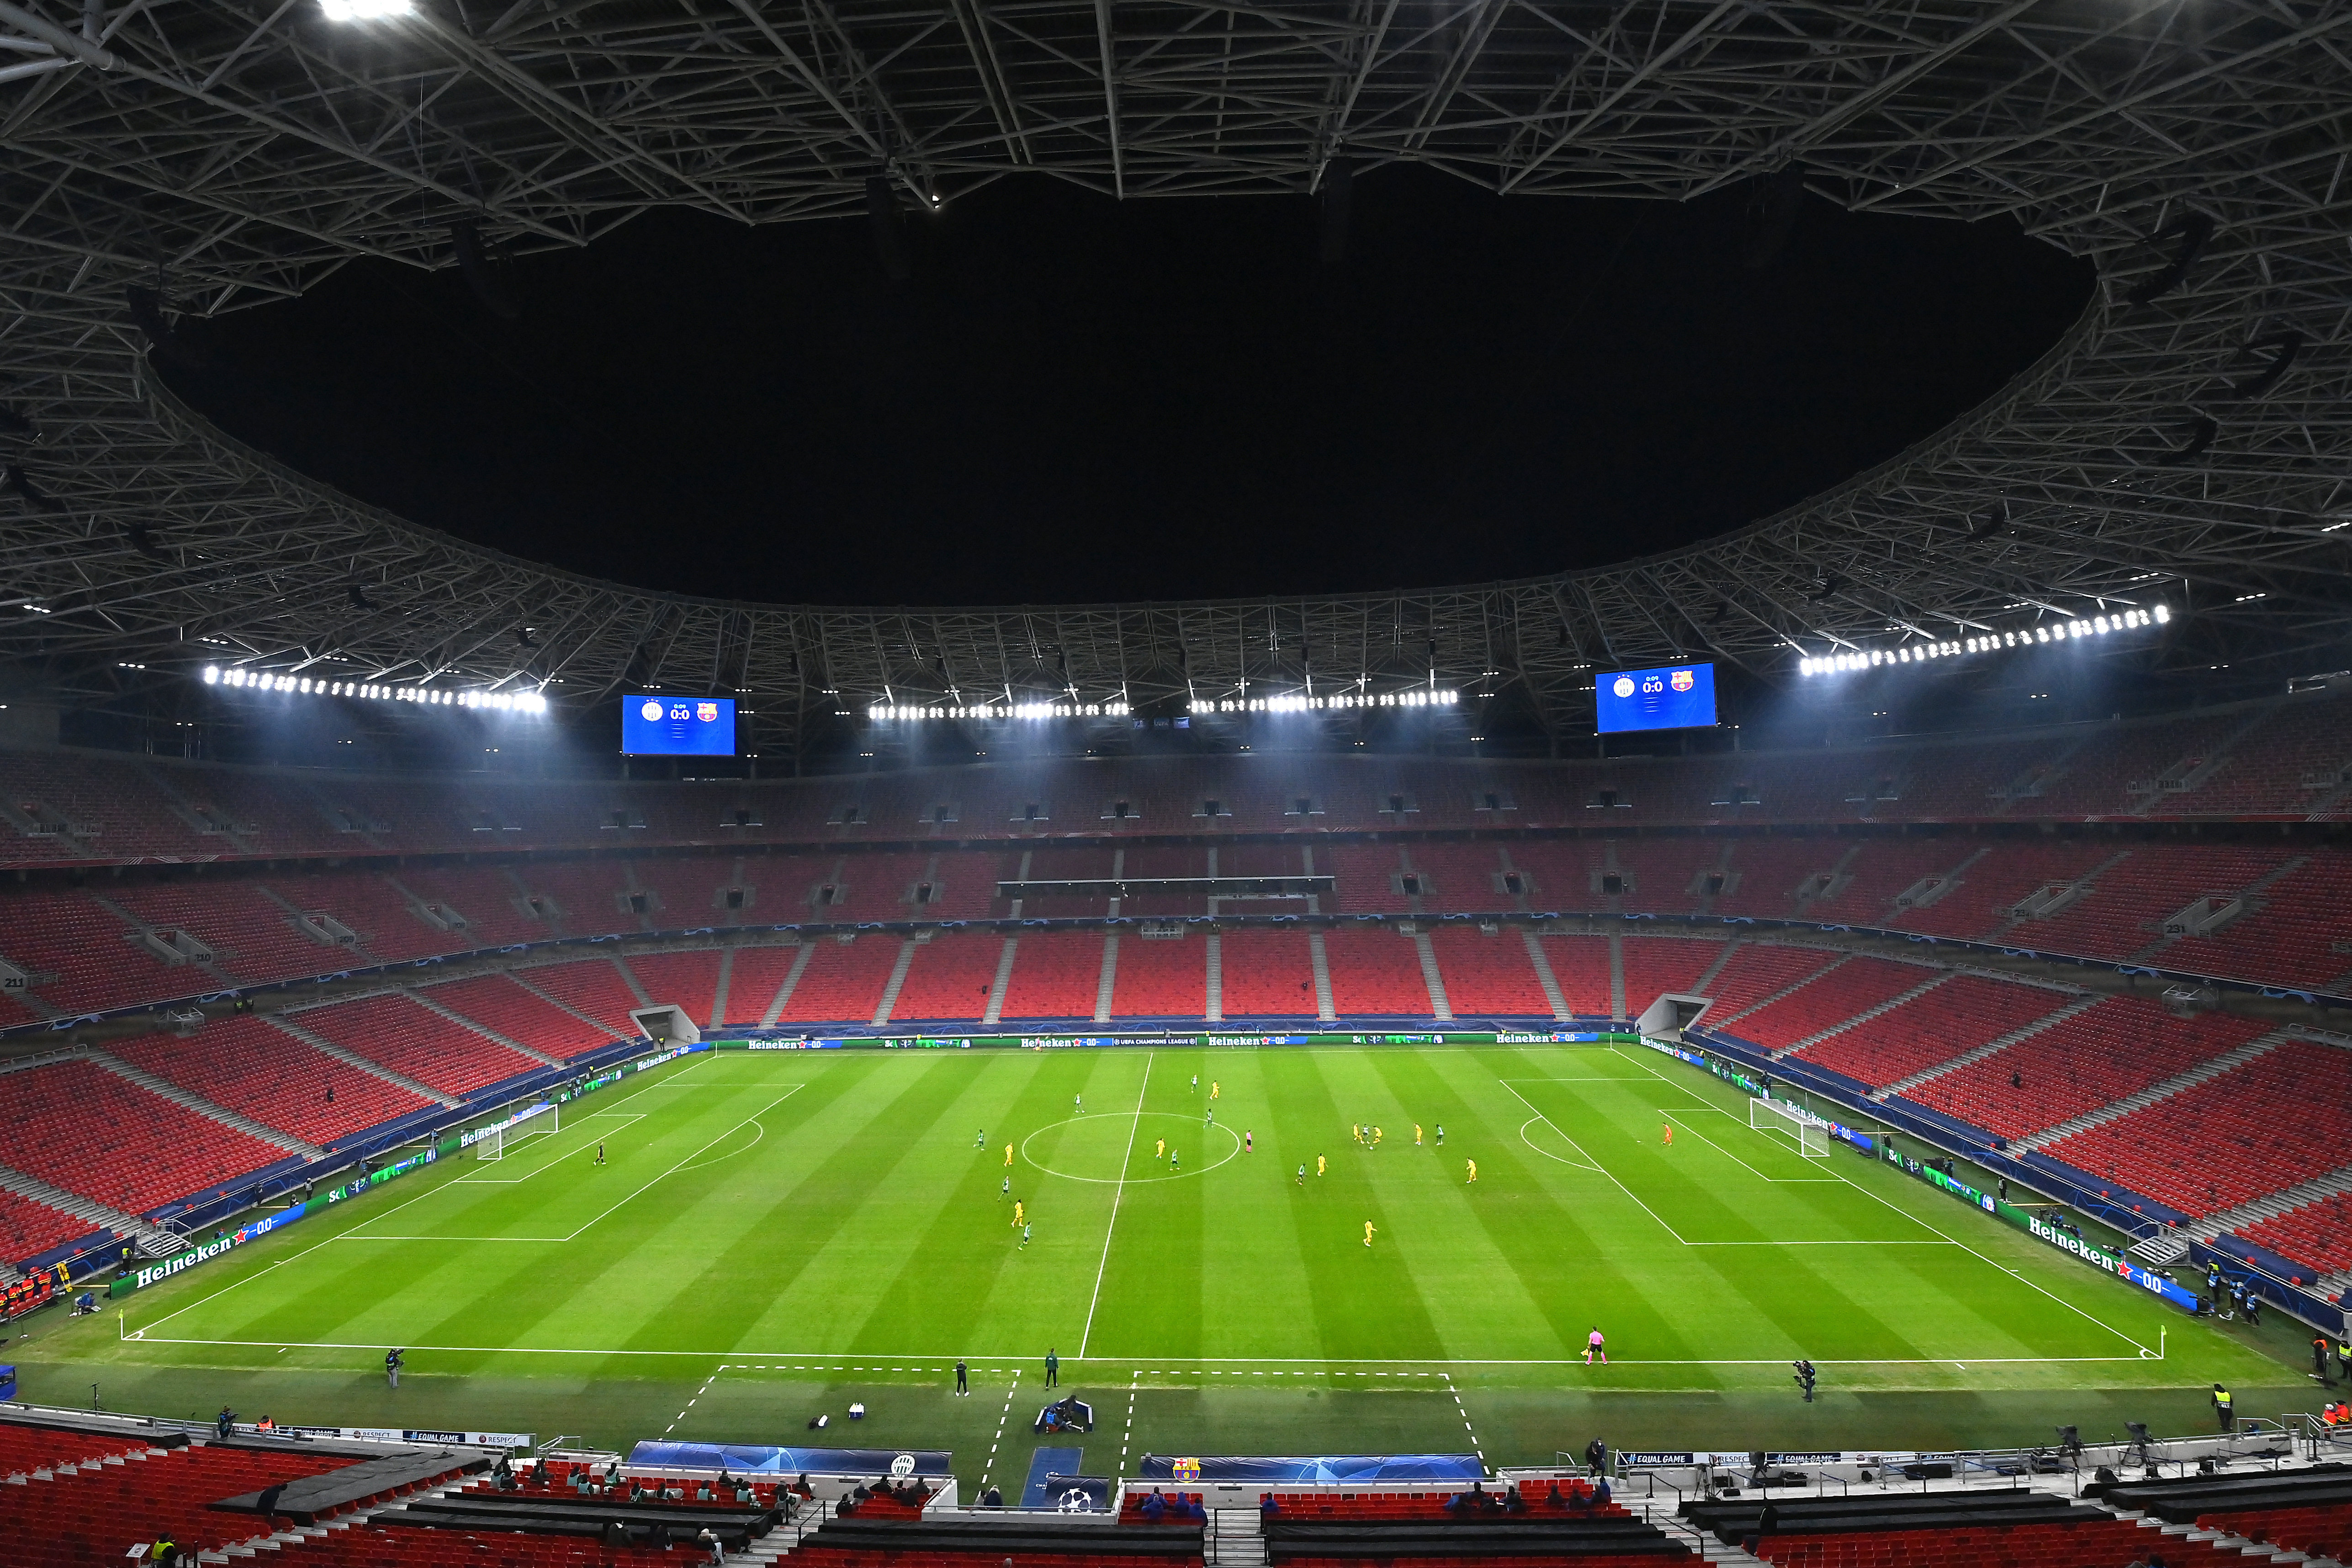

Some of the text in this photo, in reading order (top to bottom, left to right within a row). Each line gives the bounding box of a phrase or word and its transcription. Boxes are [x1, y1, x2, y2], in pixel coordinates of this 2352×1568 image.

[1642, 681, 1663, 693] 0:0
[670, 709, 689, 720] 0:0
[5, 978, 23, 987] 211
[1208, 1037, 1260, 1046] Heineken
[1496, 1034, 1549, 1043] Heineken
[748, 1041, 797, 1049] Heineken
[1640, 1035, 1674, 1055] Heineken
[637, 1053, 671, 1071] Heineken
[460, 1120, 509, 1148] Heineken
[2029, 1216, 2114, 1272] Heineken
[136, 1238, 232, 1288] Heineken
